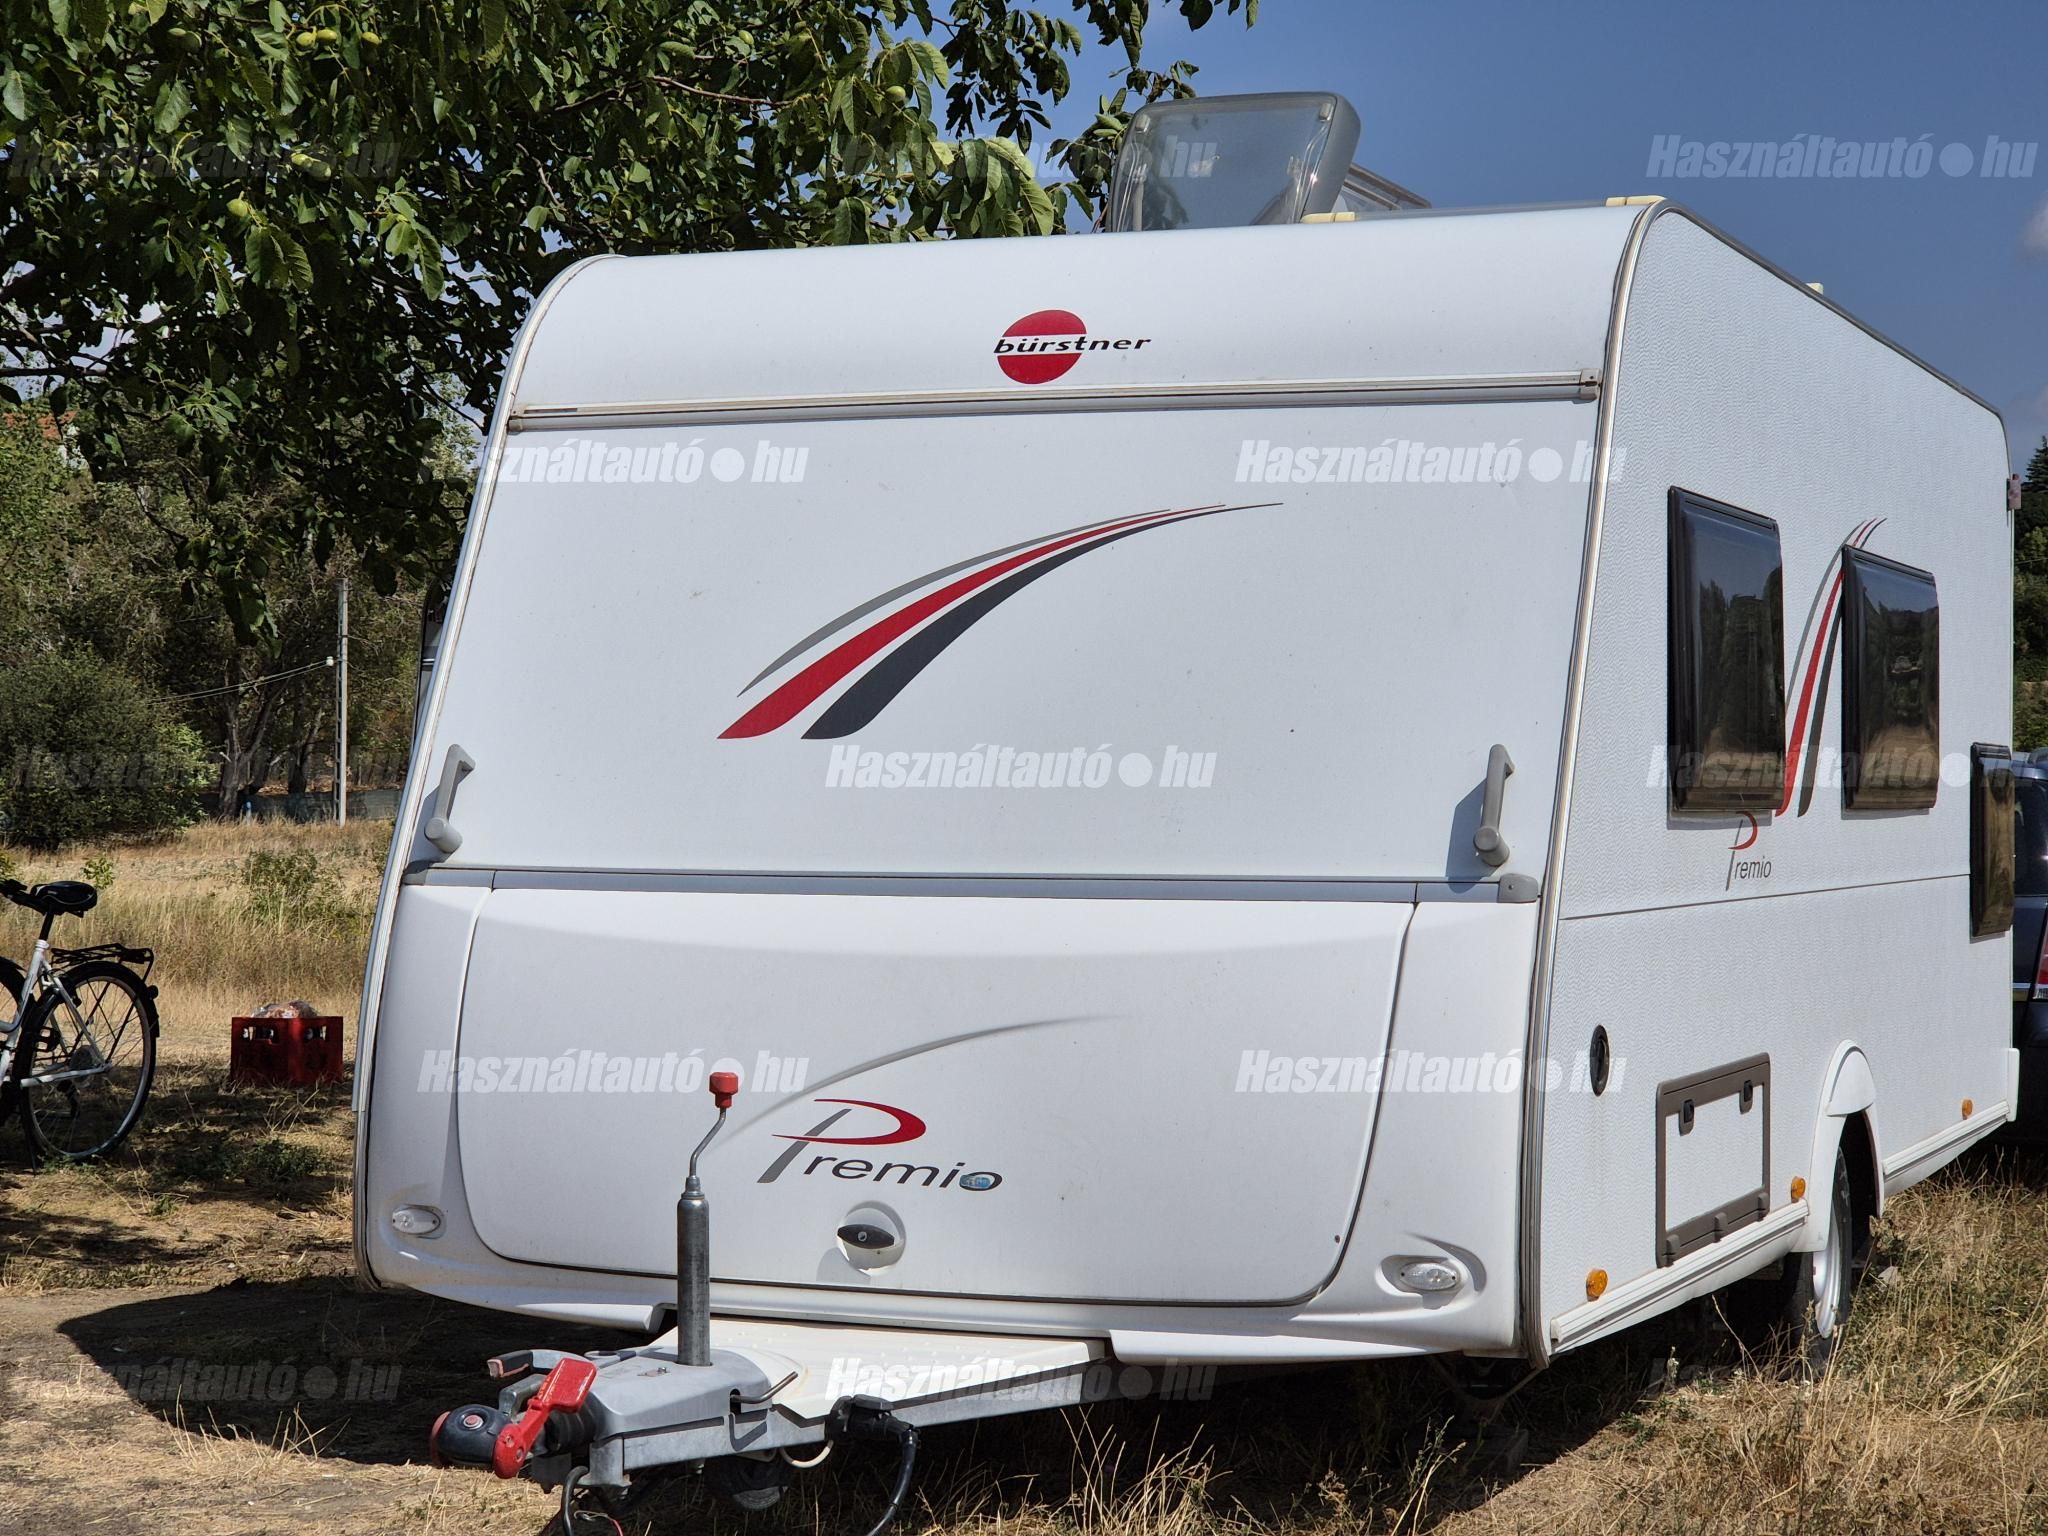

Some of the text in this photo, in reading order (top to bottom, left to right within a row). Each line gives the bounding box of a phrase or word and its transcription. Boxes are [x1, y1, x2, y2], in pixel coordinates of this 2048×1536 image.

[994, 336, 1151, 353] bürstner
[1726, 811, 1772, 891] Premio
[757, 1099, 1002, 1191] Premio
